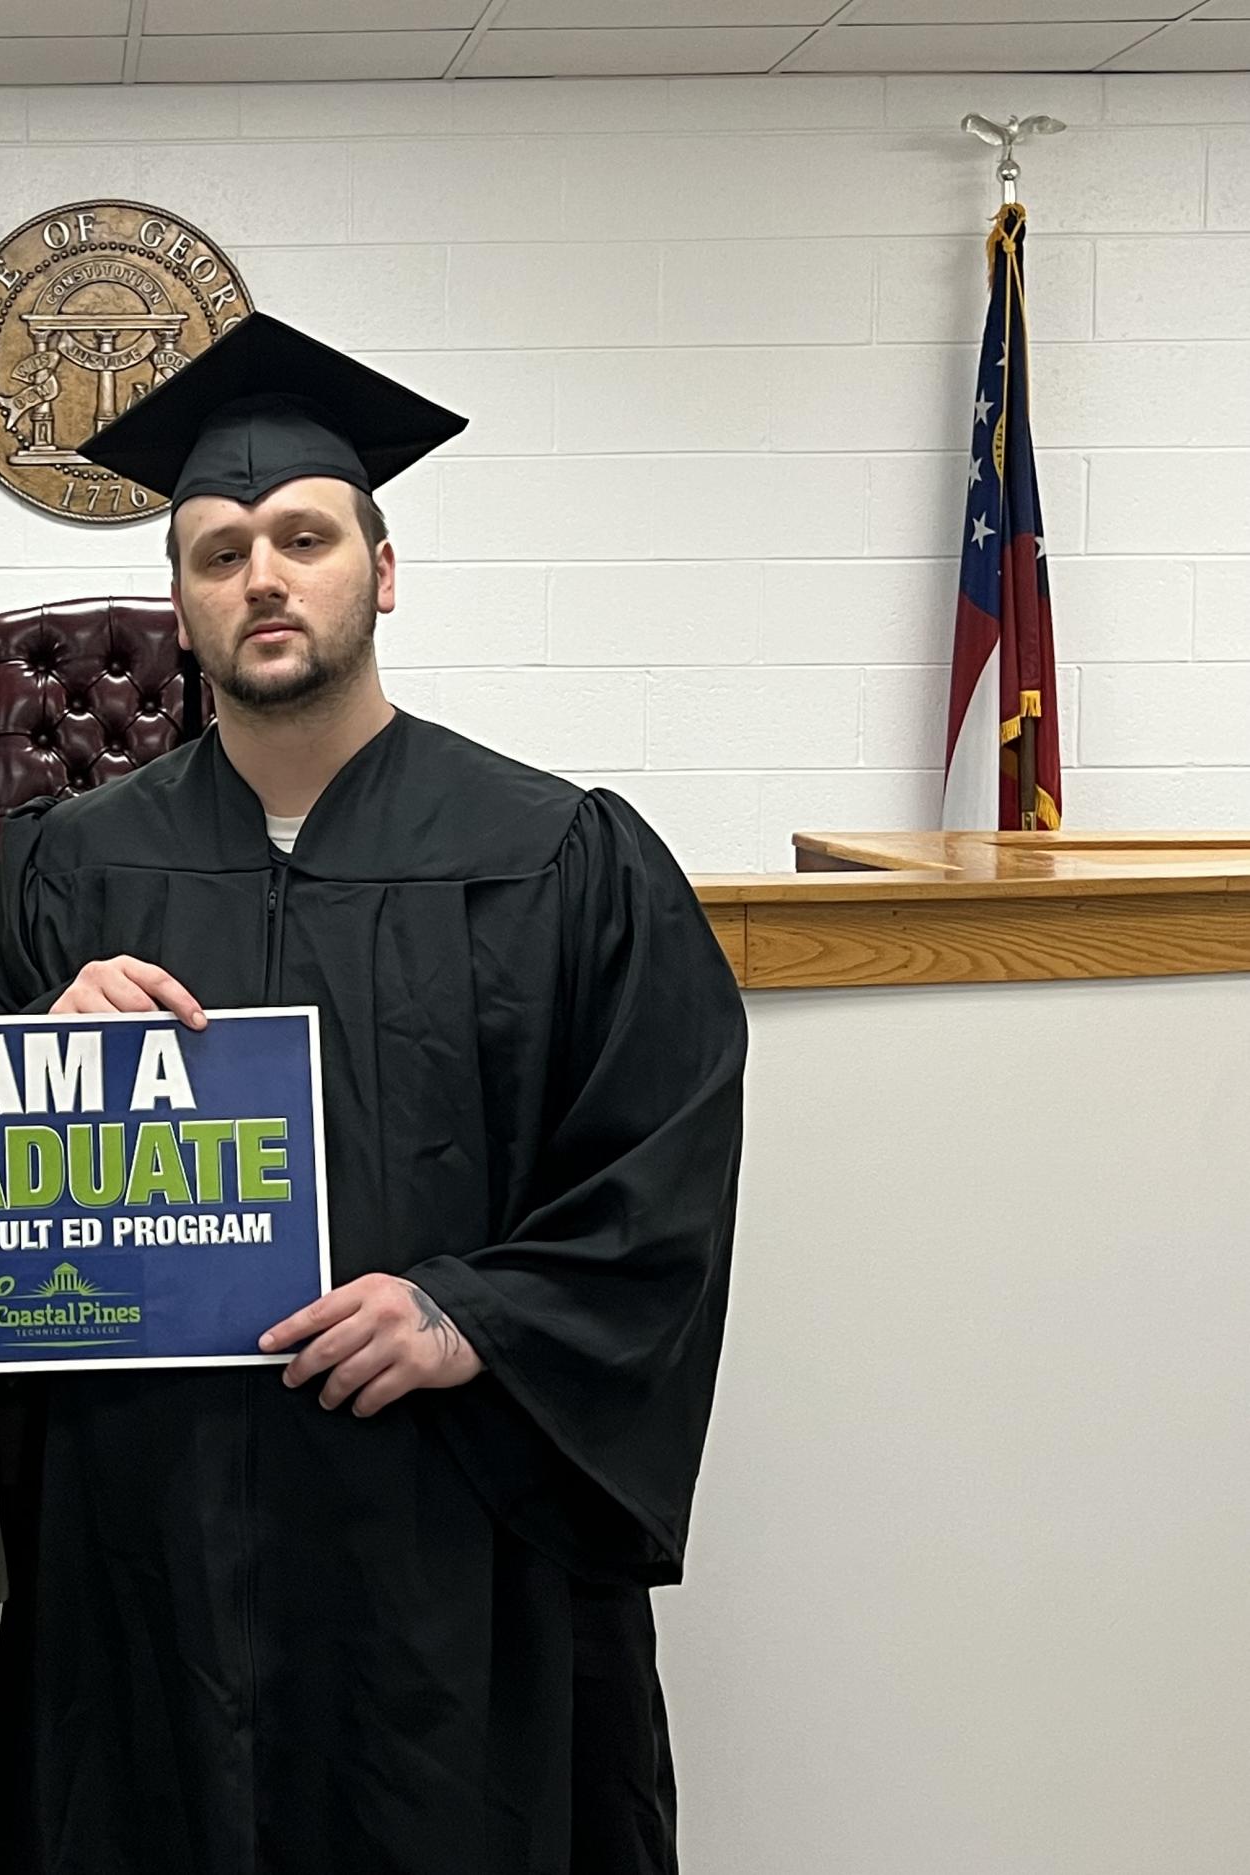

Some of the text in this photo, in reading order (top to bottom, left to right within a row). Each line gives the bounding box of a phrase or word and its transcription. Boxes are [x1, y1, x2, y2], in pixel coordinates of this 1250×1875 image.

[43, 213, 95, 249] OF
[46, 262, 163, 305] CONSTITUTION
[67, 347, 141, 368] JUSTICE
[62, 482, 148, 512] 1776
[130, 1029, 197, 1111] A
[62, 1218, 102, 1249] ED
[112, 1213, 273, 1247] PROGRAM
[78, 1302, 142, 1326] Pines
[15, 1325, 121, 1337] TECHNICAL COLLEGE
